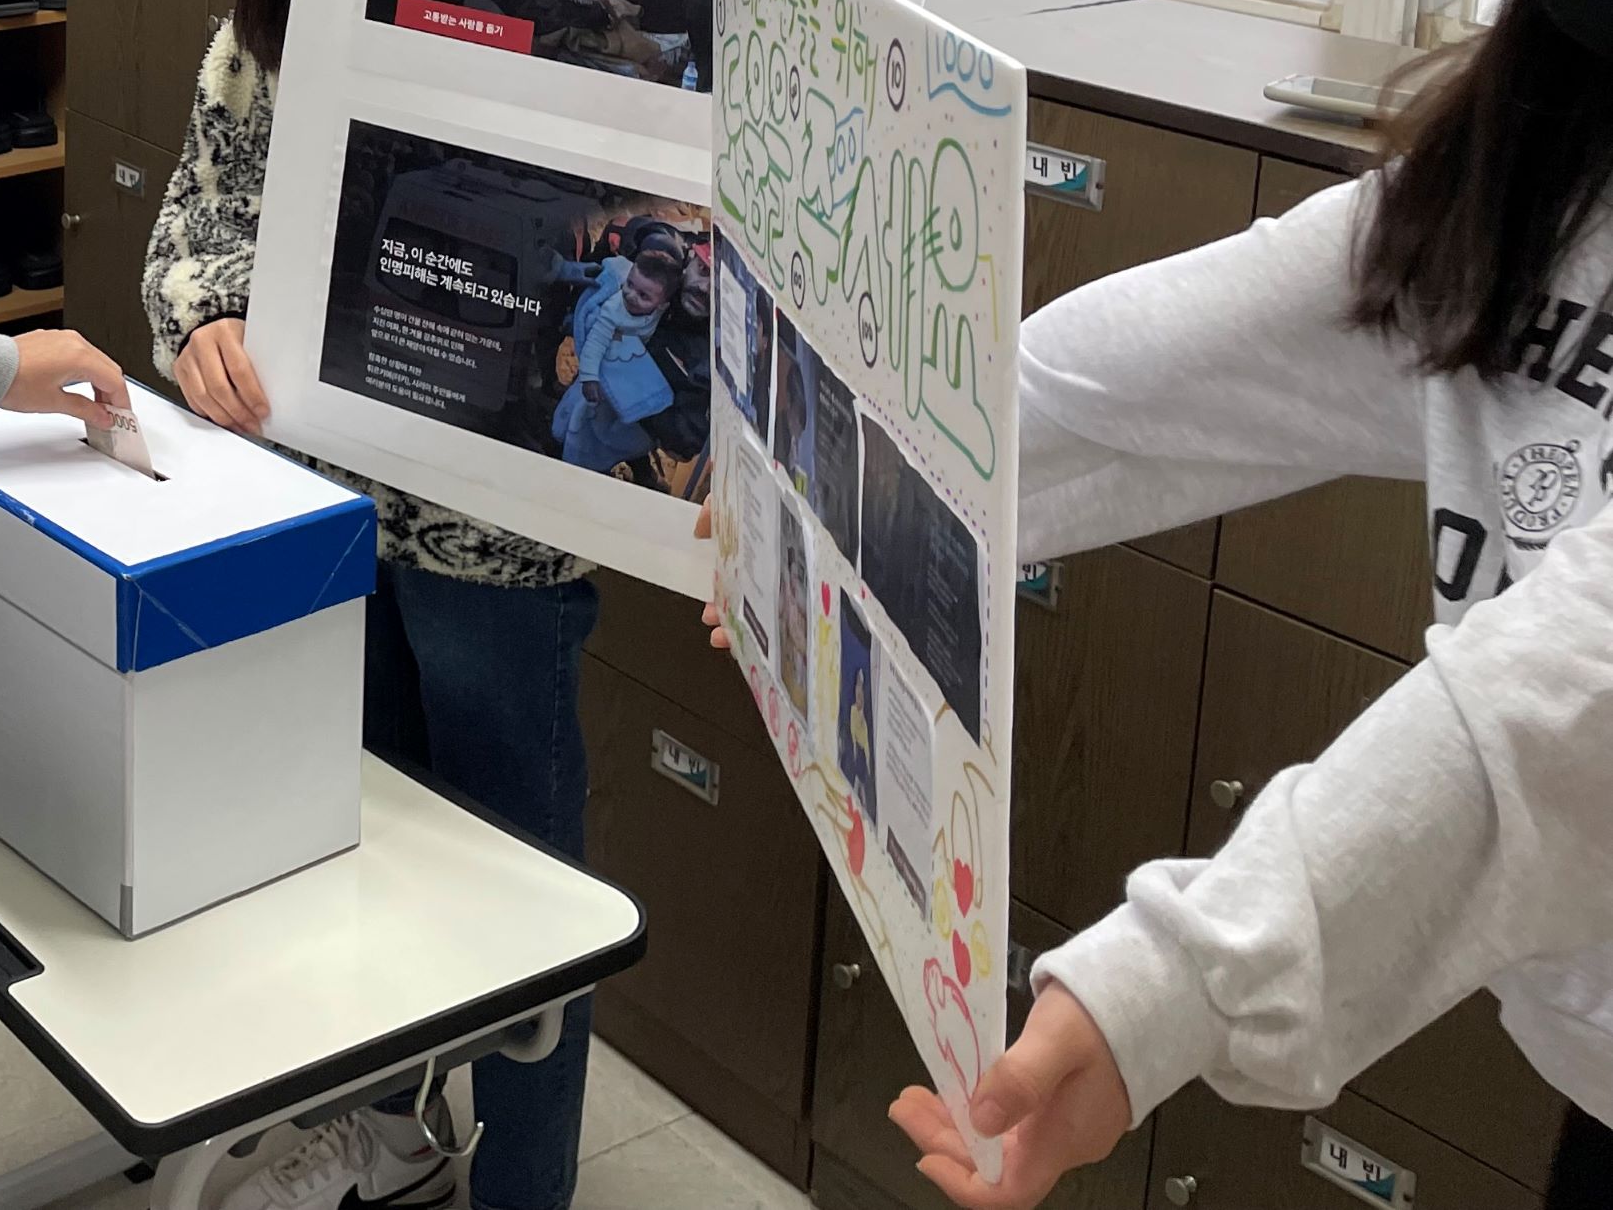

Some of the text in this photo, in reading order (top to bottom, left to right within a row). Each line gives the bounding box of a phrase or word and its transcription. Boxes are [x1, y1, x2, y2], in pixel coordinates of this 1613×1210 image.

[423, 10, 457, 26] 고통받는
[458, 17, 484, 33] 사람들
[381, 238, 474, 277] 지금, 이 순간에도
[380, 257, 542, 316] 인명피해는 계속되고 있습니다
